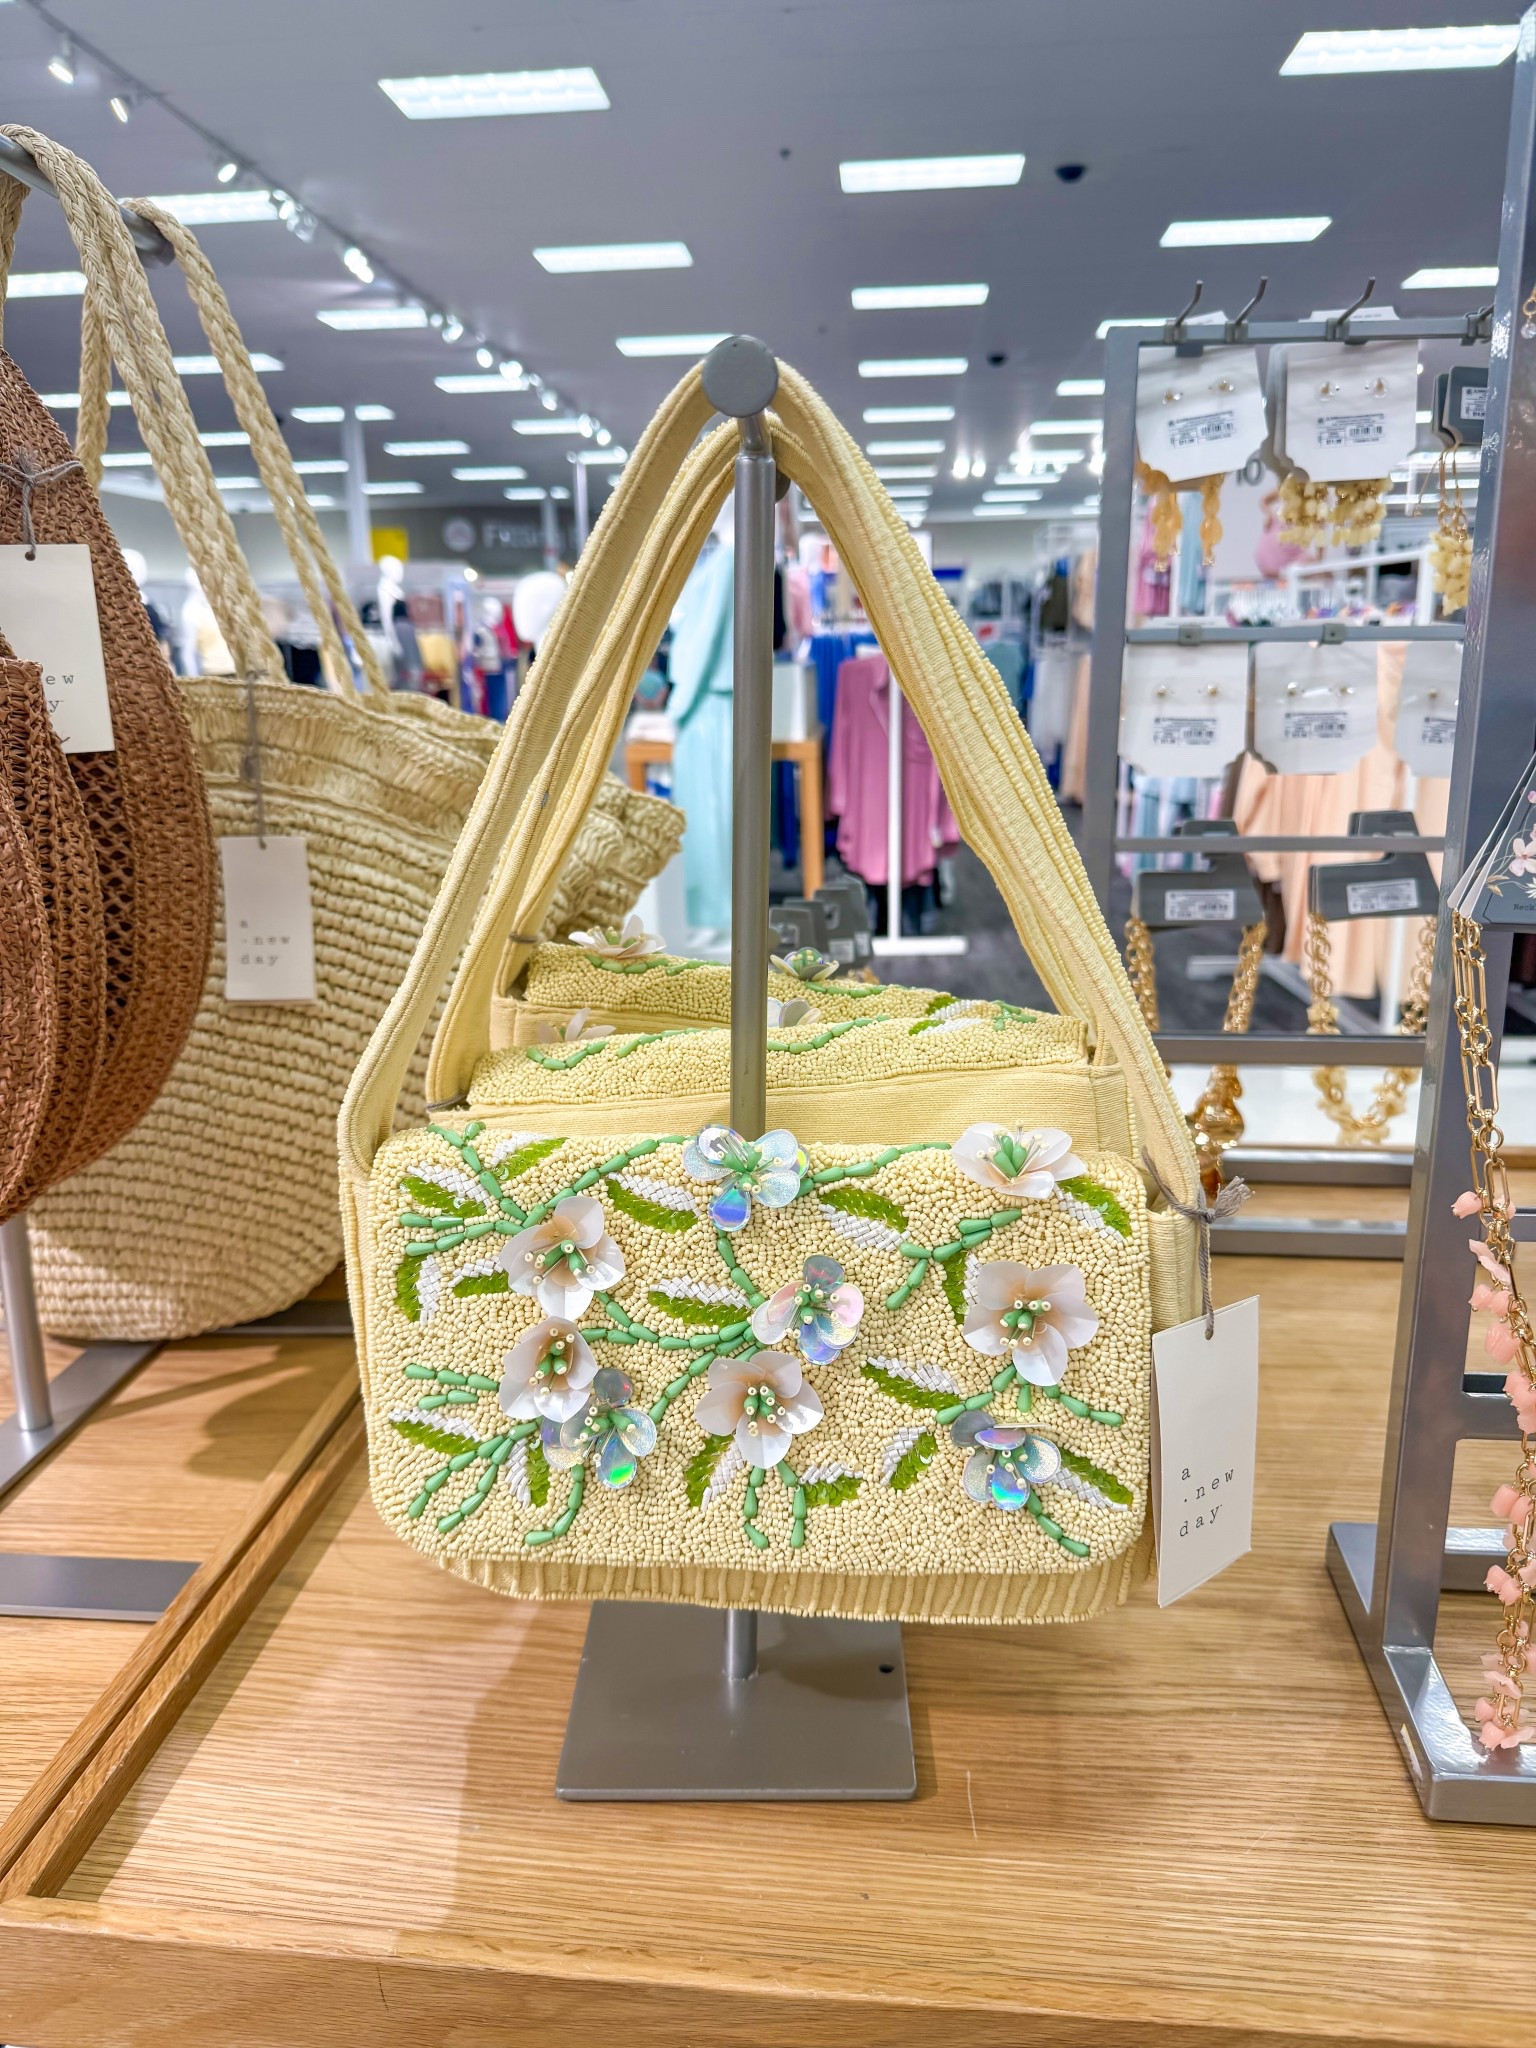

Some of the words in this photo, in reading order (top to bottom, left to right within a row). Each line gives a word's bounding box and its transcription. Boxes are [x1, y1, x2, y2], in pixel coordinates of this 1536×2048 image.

[45, 674, 74, 685] ew
[240, 920, 248, 929] a
[241, 953, 278, 967] day
[1181, 1467, 1191, 1481] a
[1179, 1505, 1220, 1537] day
